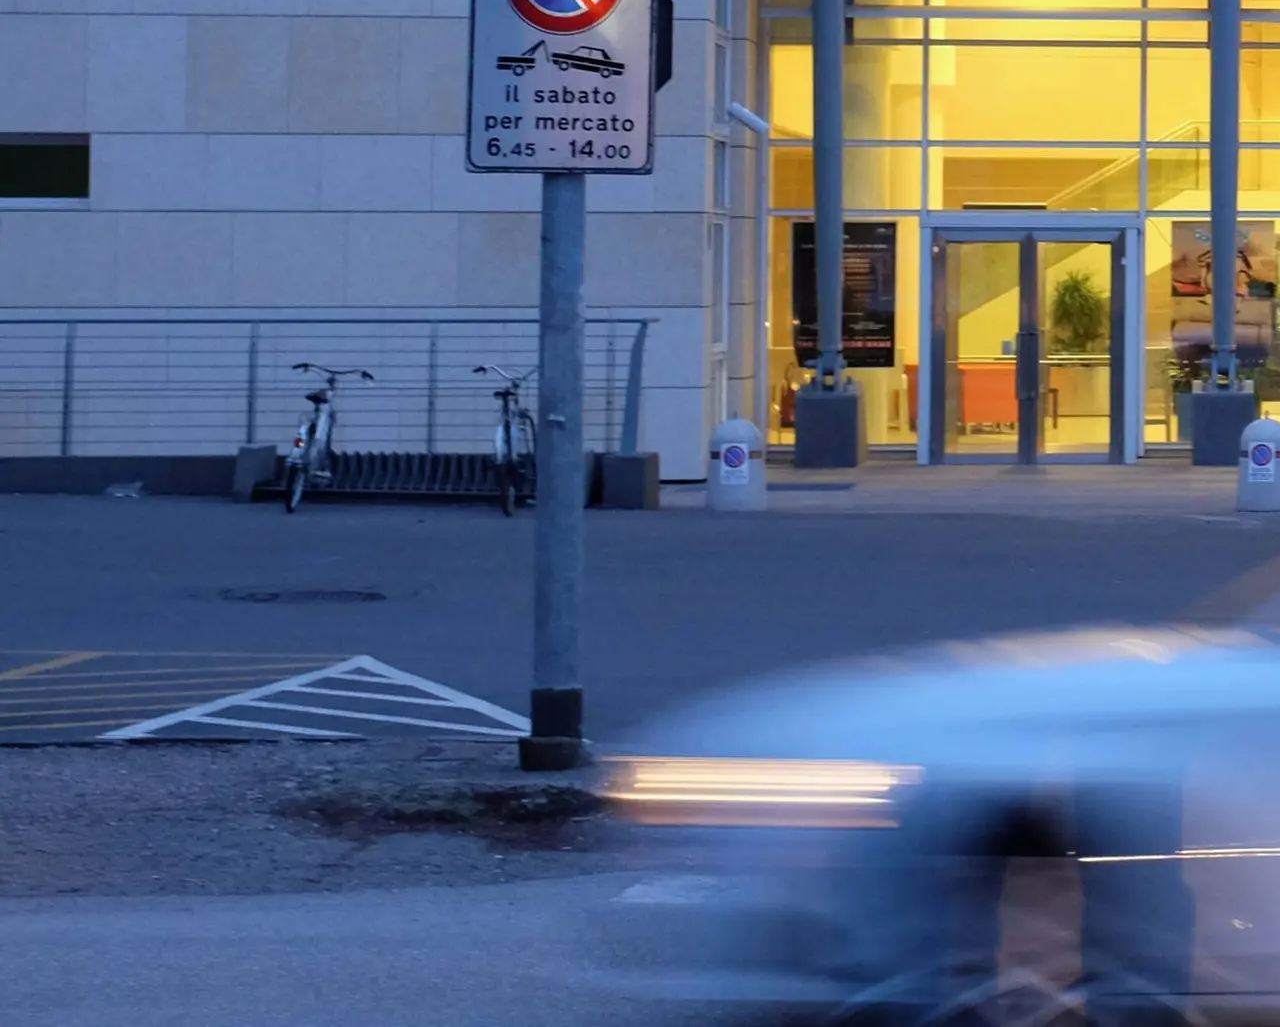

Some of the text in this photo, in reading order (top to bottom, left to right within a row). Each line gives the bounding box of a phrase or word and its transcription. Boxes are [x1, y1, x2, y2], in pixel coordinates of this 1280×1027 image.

[504, 84, 617, 105] il sabato
[484, 114, 635, 132] per mercato
[486, 137, 537, 158] 6.45
[568, 139, 632, 159] 14.00
